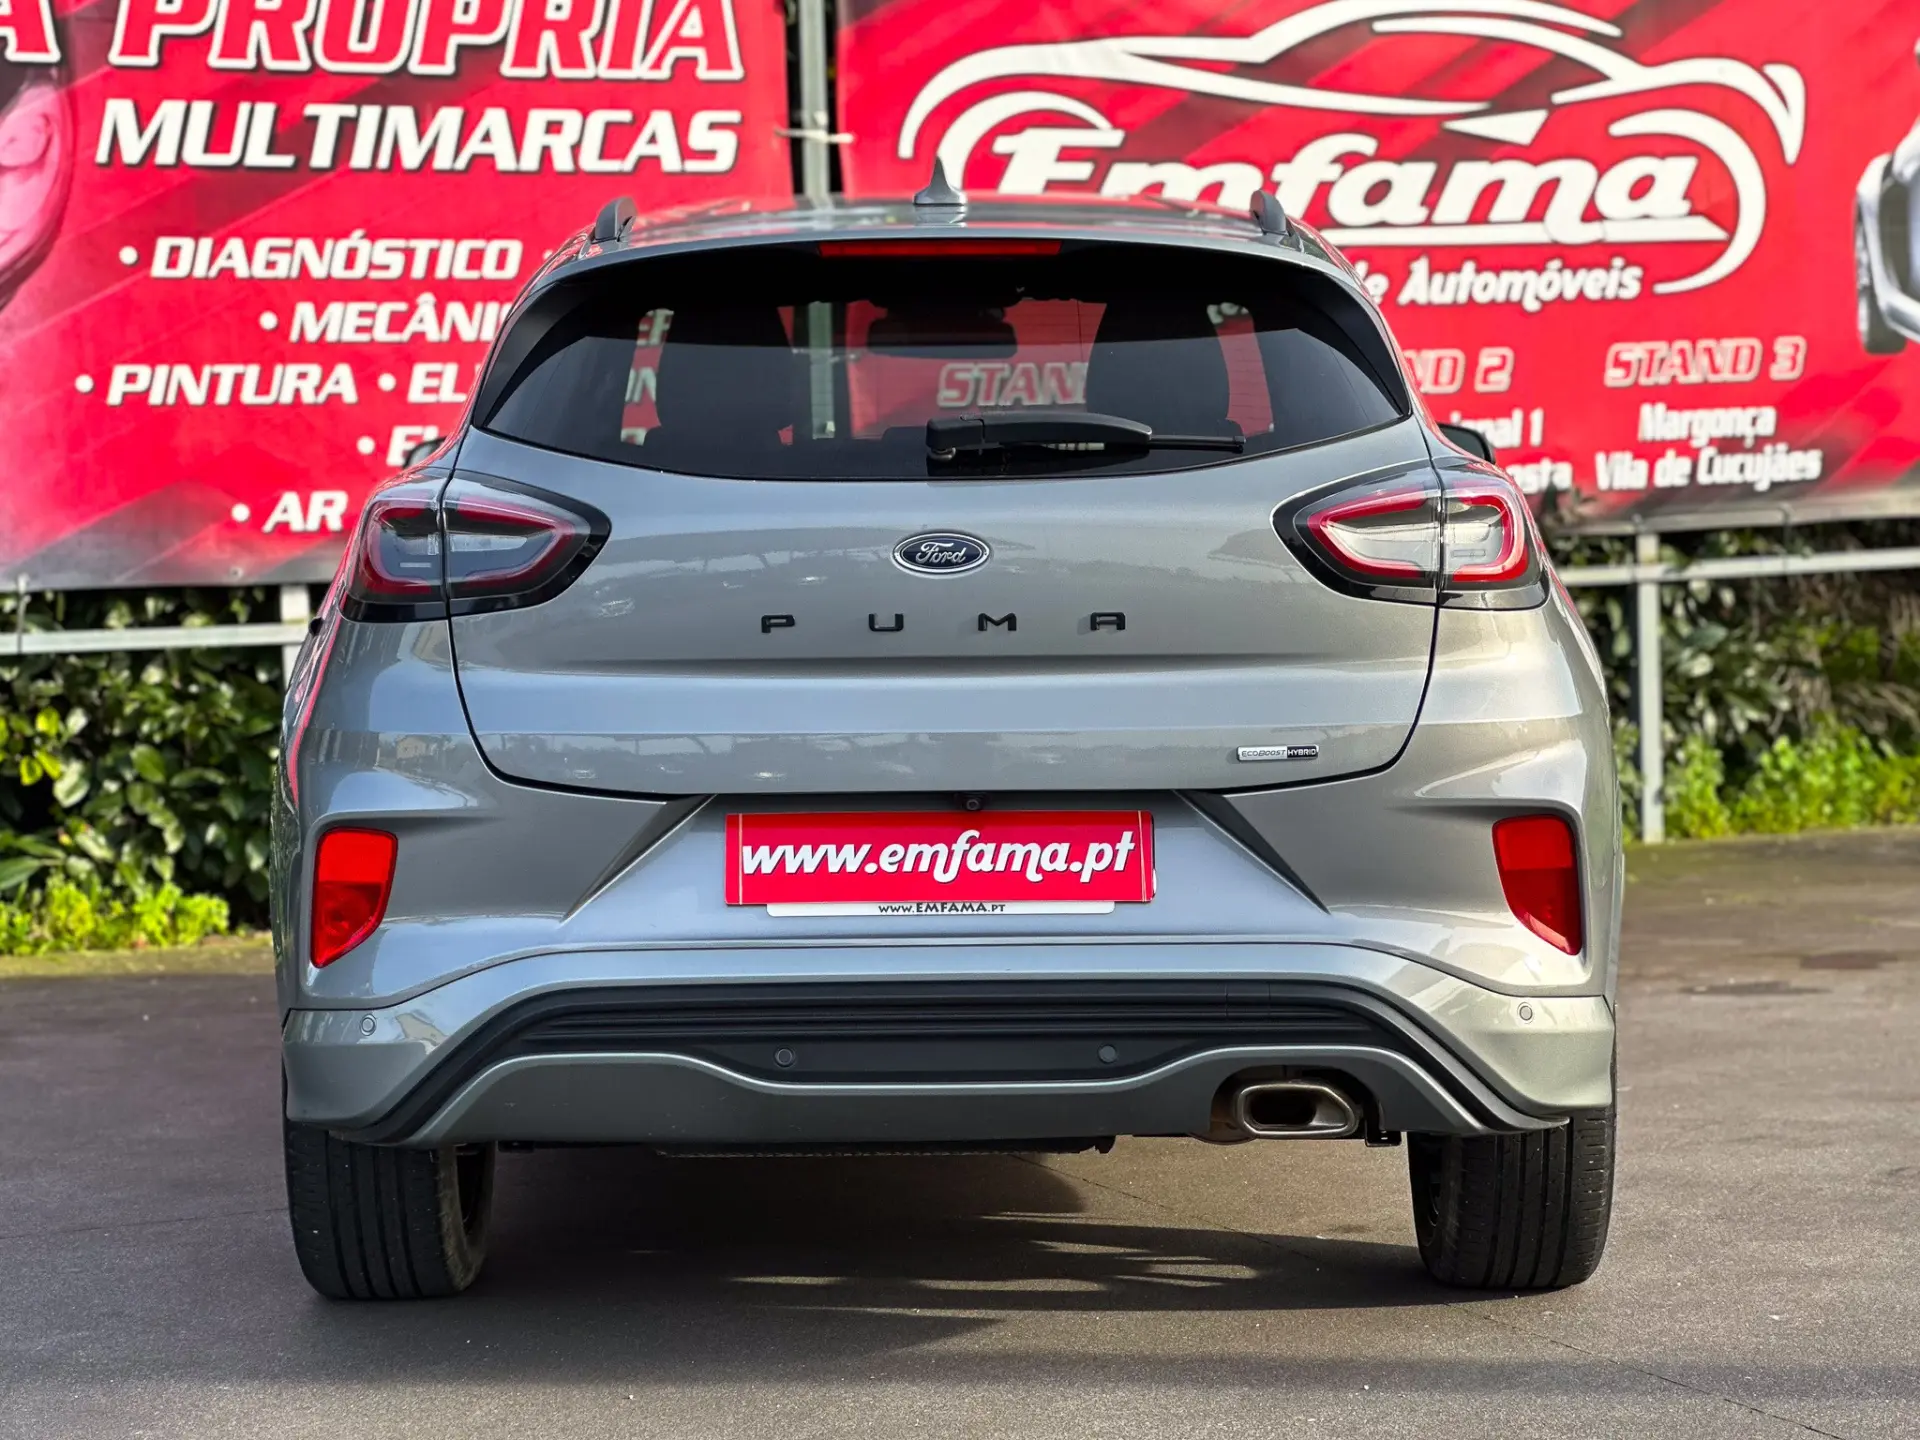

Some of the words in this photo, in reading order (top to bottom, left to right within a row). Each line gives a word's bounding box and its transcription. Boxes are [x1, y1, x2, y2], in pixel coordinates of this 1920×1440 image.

[95, 98, 742, 173] MULTIMARCAS
[992, 127, 1699, 244] Emfama
[150, 230, 523, 280] DIAGNÓSTICO
[1396, 254, 1643, 313] Automóveis
[289, 293, 513, 343] MECÂNI
[106, 363, 358, 406] PINTURA
[406, 362, 481, 403] EL
[1474, 346, 1514, 393] 2
[1604, 336, 1763, 387] STAND
[1769, 335, 1807, 381] 3
[1637, 402, 1776, 448] Margonça
[1595, 450, 1649, 490] Vila
[1653, 449, 1692, 487] de
[262, 490, 348, 533] AR
[915, 541, 967, 565] Ford
[761, 612, 1126, 634] PUMA
[1287, 748, 1317, 756] HYBRID
[742, 829, 1135, 883] www.emfama.pt
